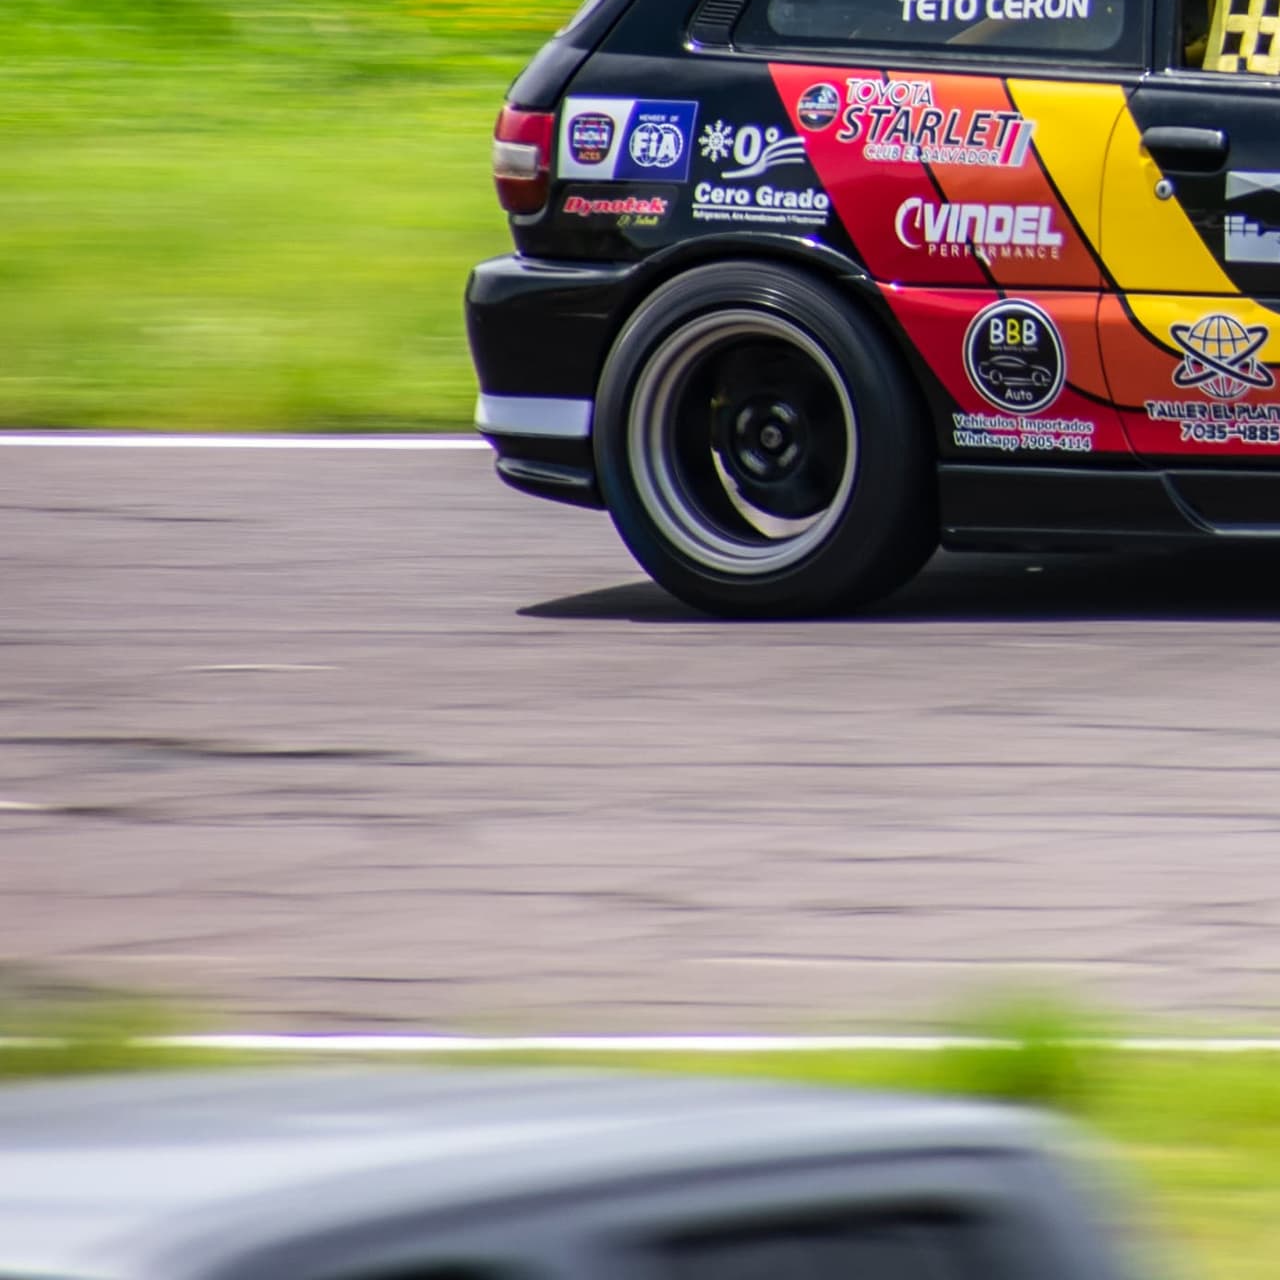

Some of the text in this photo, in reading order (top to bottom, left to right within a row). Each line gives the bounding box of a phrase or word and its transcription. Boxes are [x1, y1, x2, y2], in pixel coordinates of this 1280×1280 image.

[846, 78, 933, 107] TOYOTA
[837, 105, 1025, 149] STARLET
[863, 143, 902, 161] CLUB
[920, 146, 1001, 167] SALVADOR
[562, 196, 666, 217] Dynotek
[694, 182, 830, 210] Cero Grado
[923, 202, 1064, 247] VINDEL
[927, 243, 1061, 259] PERFORMANCE
[1004, 387, 1034, 401] Auto
[1144, 400, 1209, 421] TALLER
[1210, 403, 1235, 421] EL
[1017, 416, 1095, 434] Importados
[952, 430, 1092, 452] Whatsapp 7905-4114
